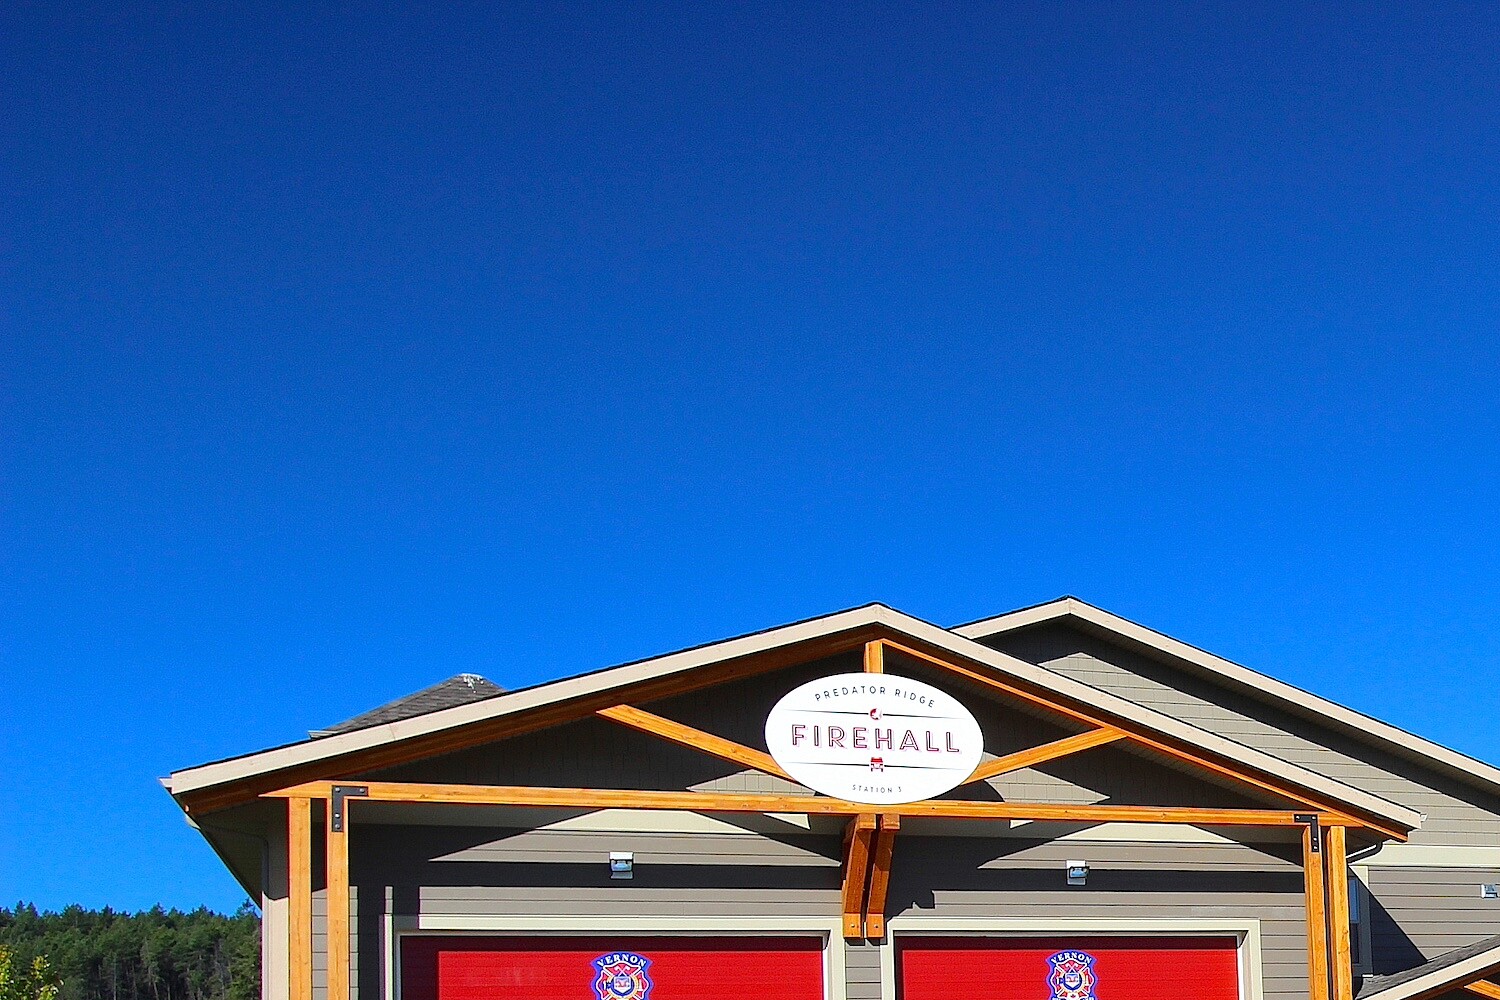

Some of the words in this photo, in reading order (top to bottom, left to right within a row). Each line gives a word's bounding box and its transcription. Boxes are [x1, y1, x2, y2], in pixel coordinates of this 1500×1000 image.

[814, 685, 886, 702] PREDATOR
[894, 688, 935, 708] RIDGE
[791, 724, 961, 753] FIREHALL
[852, 784, 893, 794] STATION
[597, 953, 647, 967] VERNON
[1050, 951, 1092, 964] VERNON
